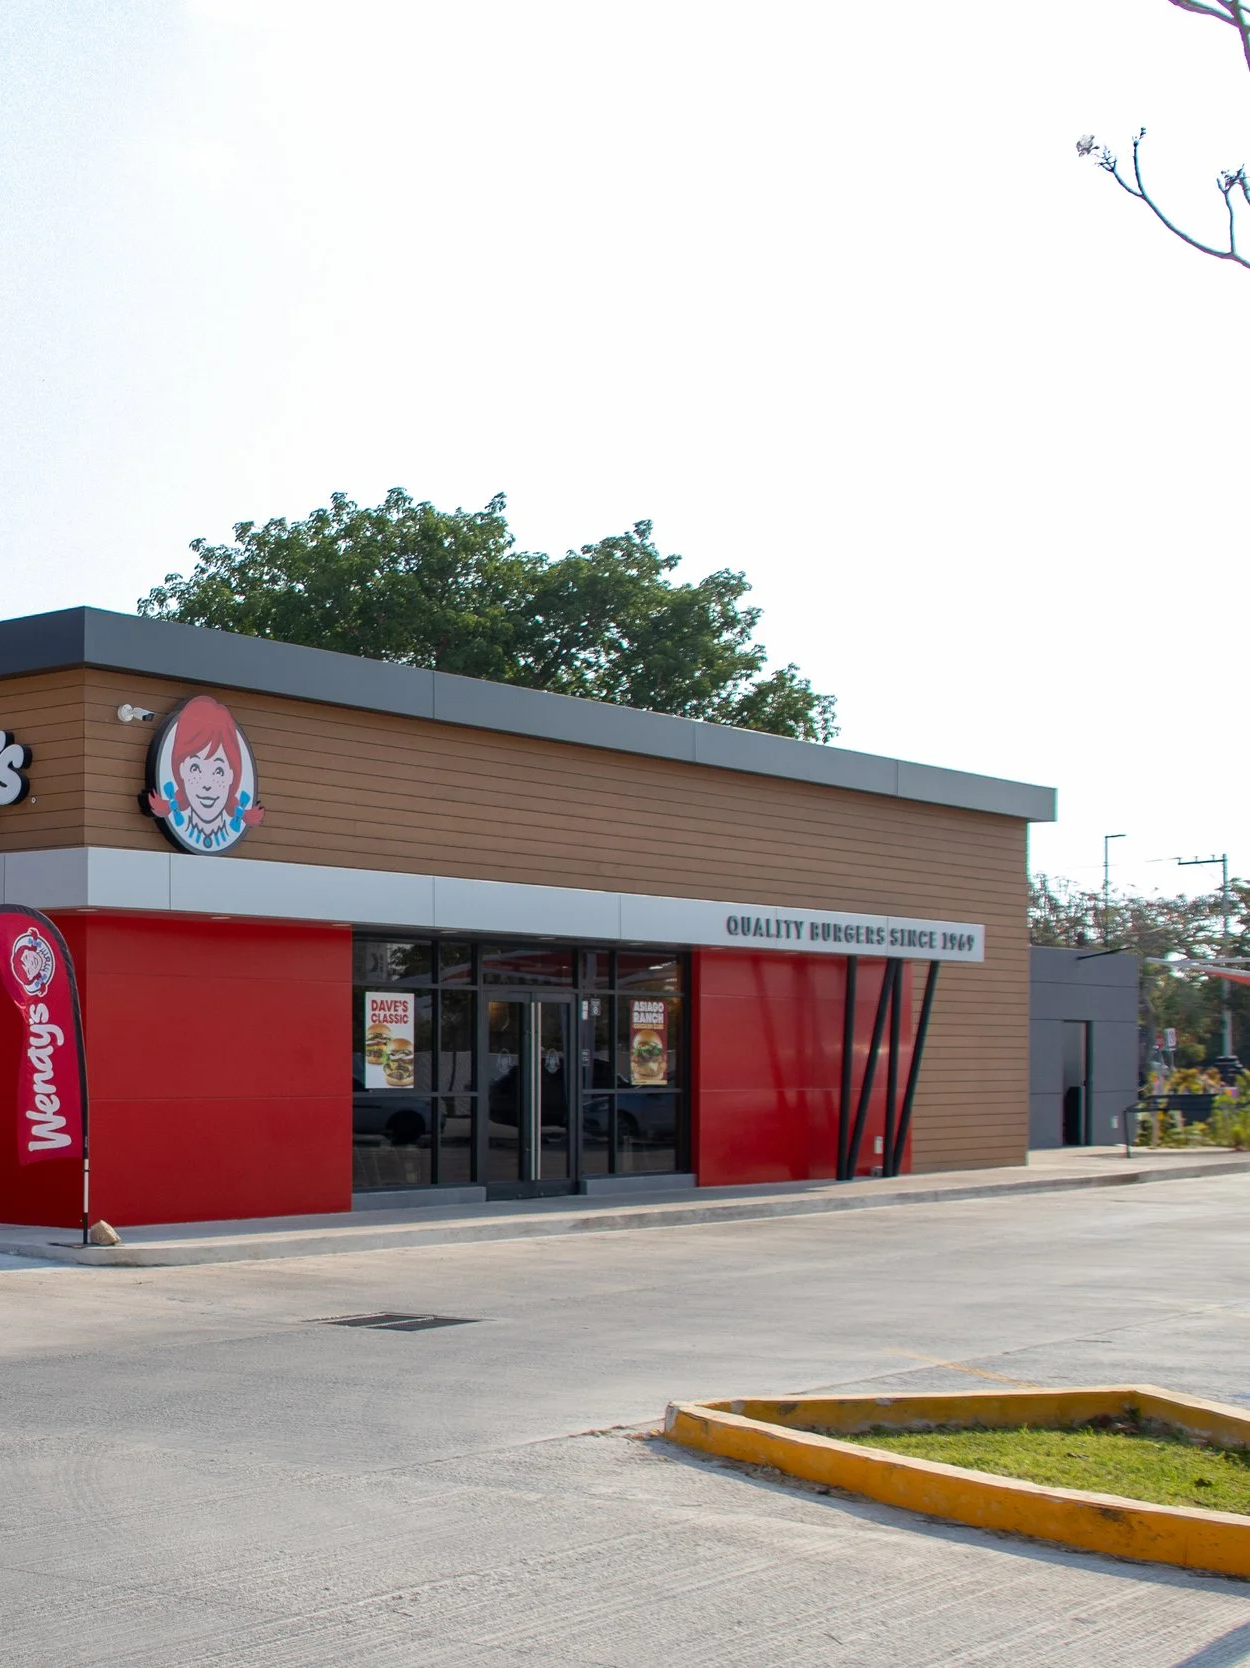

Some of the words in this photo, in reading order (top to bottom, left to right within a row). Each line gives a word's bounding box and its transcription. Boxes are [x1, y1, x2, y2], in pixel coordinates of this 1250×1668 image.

[726, 915, 805, 940] QUALITY
[810, 921, 886, 946] BURGERS
[889, 927, 937, 949] SINCE
[941, 931, 976, 952] 1969
[371, 999, 409, 1013] DAVE'S
[370, 1013, 409, 1025] CLASSIC
[633, 1012, 664, 1024] RANCH
[25, 1002, 72, 1152] Wendy's
